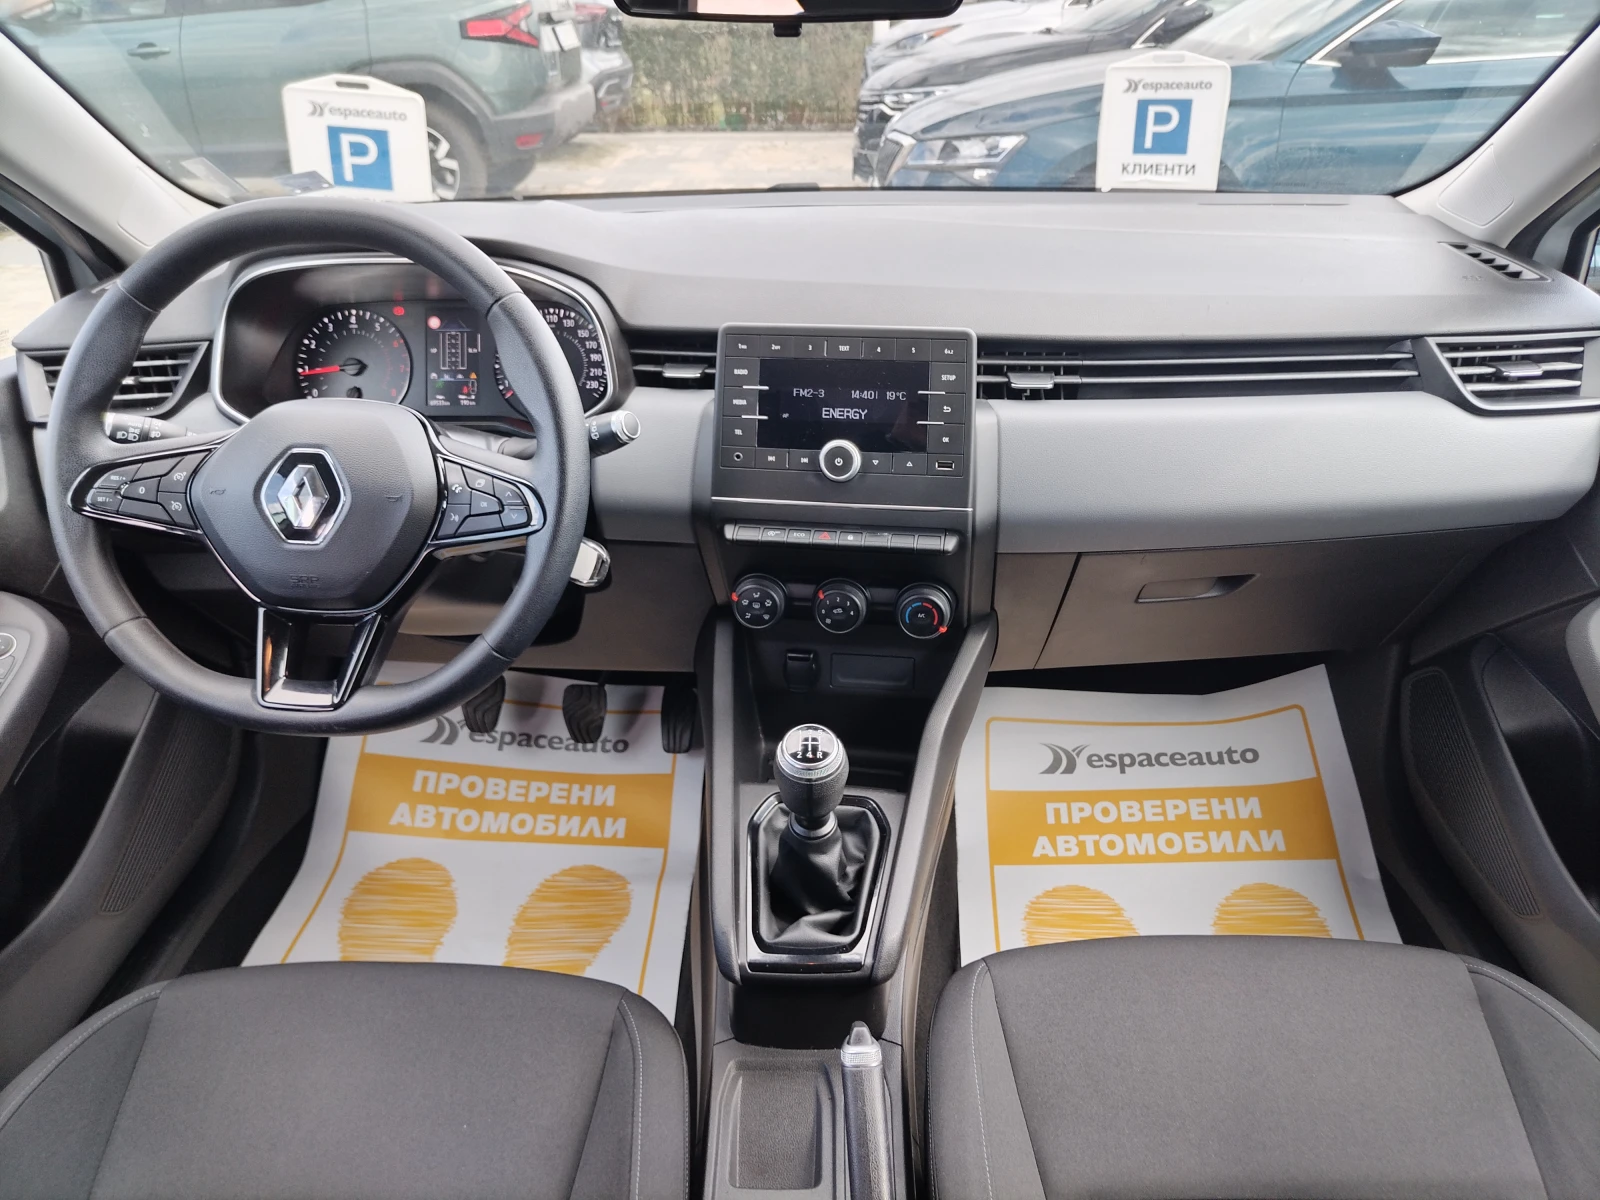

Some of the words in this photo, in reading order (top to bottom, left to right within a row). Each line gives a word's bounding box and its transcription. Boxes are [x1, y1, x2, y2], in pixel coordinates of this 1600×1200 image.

[1142, 80, 1212, 92] espaceauto
[329, 105, 407, 121] espaceauto
[1144, 104, 1180, 149] P
[340, 133, 378, 182] P
[1121, 163, 1197, 175] КЛИЕНТИ
[546, 315, 558, 323] 110
[563, 319, 575, 328] 130
[328, 323, 334, 332] 3
[375, 322, 381, 332] 5
[577, 329, 590, 338] 150
[311, 340, 317, 349] 2
[585, 341, 598, 349] 170
[590, 353, 602, 362] 190
[589, 368, 602, 376] 210
[586, 381, 599, 389] 230
[312, 388, 319, 398] 0
[793, 388, 825, 398] FM2-3
[851, 390, 874, 399] 14:40
[822, 407, 868, 420] ENERGY
[1086, 746, 1260, 774] espaceauto
[412, 769, 616, 806] ПРОВЕРЕНИ
[1045, 797, 1262, 824] ПРОВЕРЕНИ
[389, 802, 626, 839] АВТОМОБИЛИ
[1032, 829, 1286, 857] АВТОМОБИЛИ
